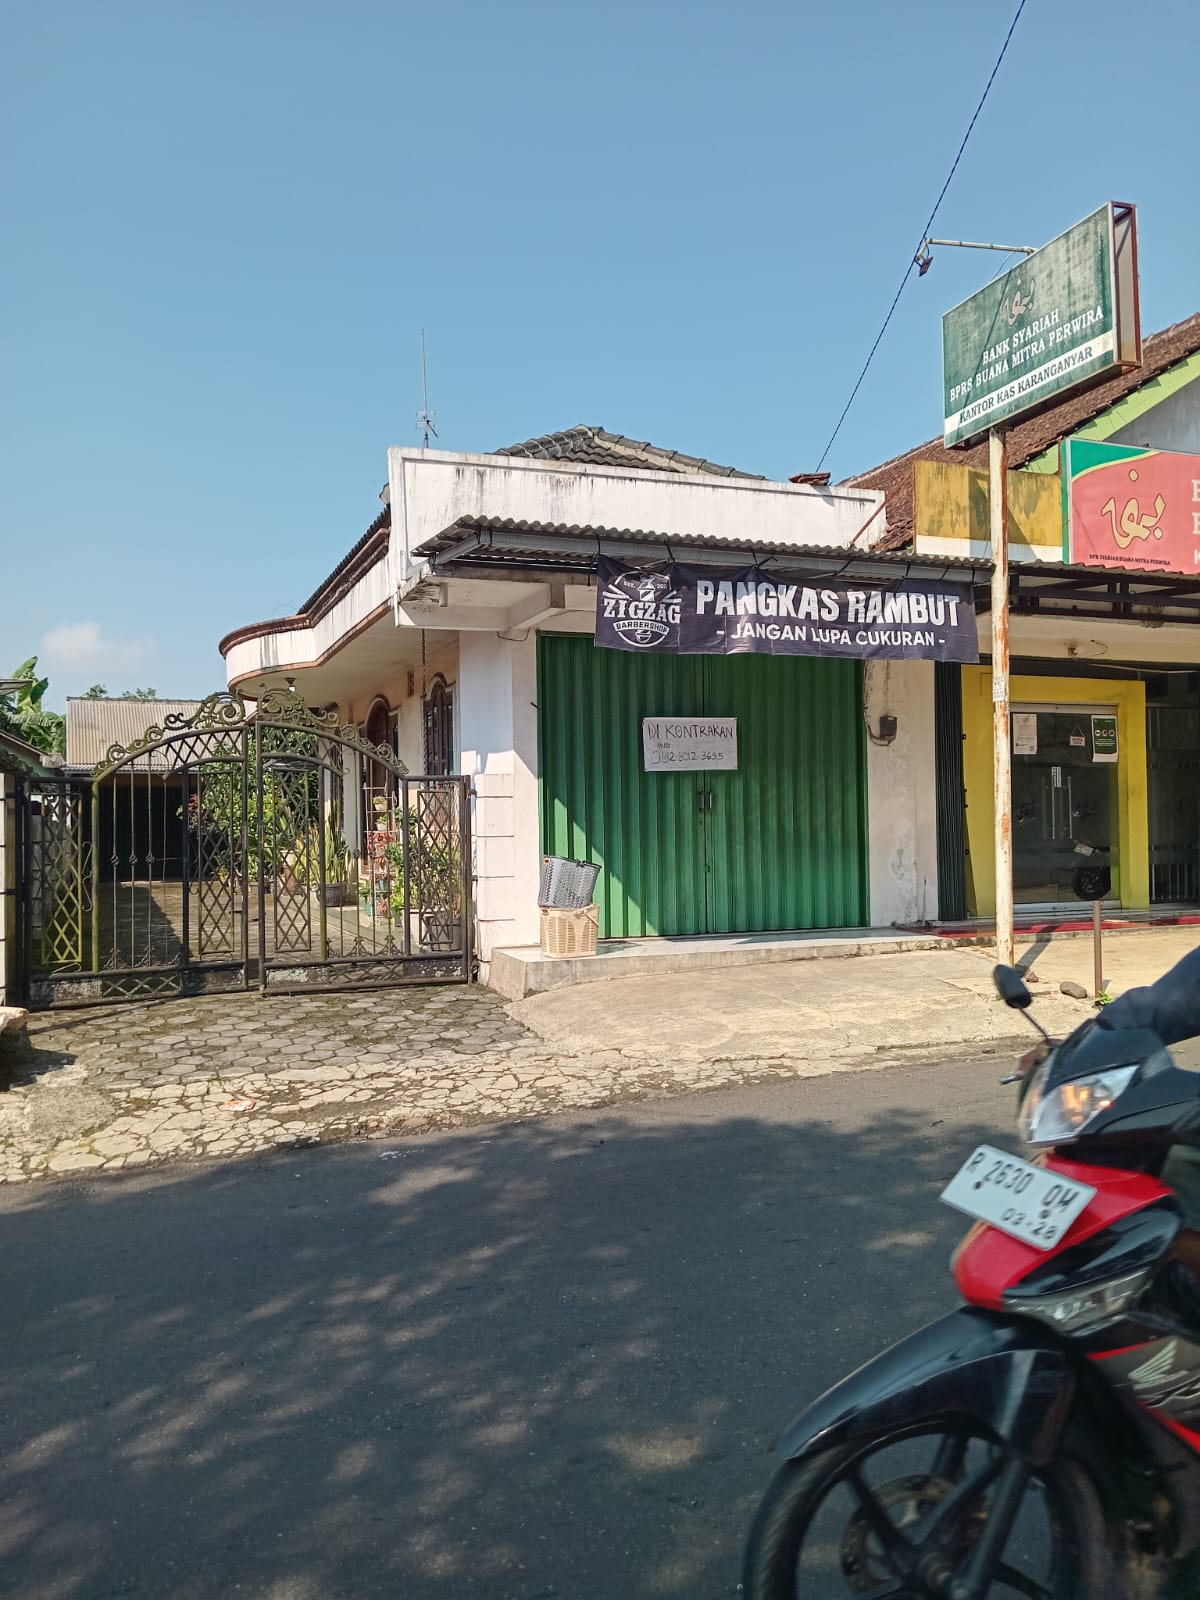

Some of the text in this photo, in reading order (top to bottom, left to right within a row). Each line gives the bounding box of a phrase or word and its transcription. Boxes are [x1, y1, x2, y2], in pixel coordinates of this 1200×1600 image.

[949, 305, 1104, 402] BPRS BUANA MITRA PERWIRA
[983, 308, 1059, 365] BANK SYARIAH
[959, 345, 1093, 424] KANTOR KAS KARANGANYAR
[603, 598, 681, 624] ZIGZAG
[696, 579, 960, 627] PANGKAS RAMBUT
[615, 621, 668, 634] BARBERSHOP
[730, 622, 807, 641] JANGAN
[811, 627, 852, 645] LUPA
[855, 630, 935, 647] CUKURAN
[648, 723, 733, 740] DI KONTRAKAN
[965, 1151, 985, 1173] R
[982, 1159, 1035, 1195] 2630
